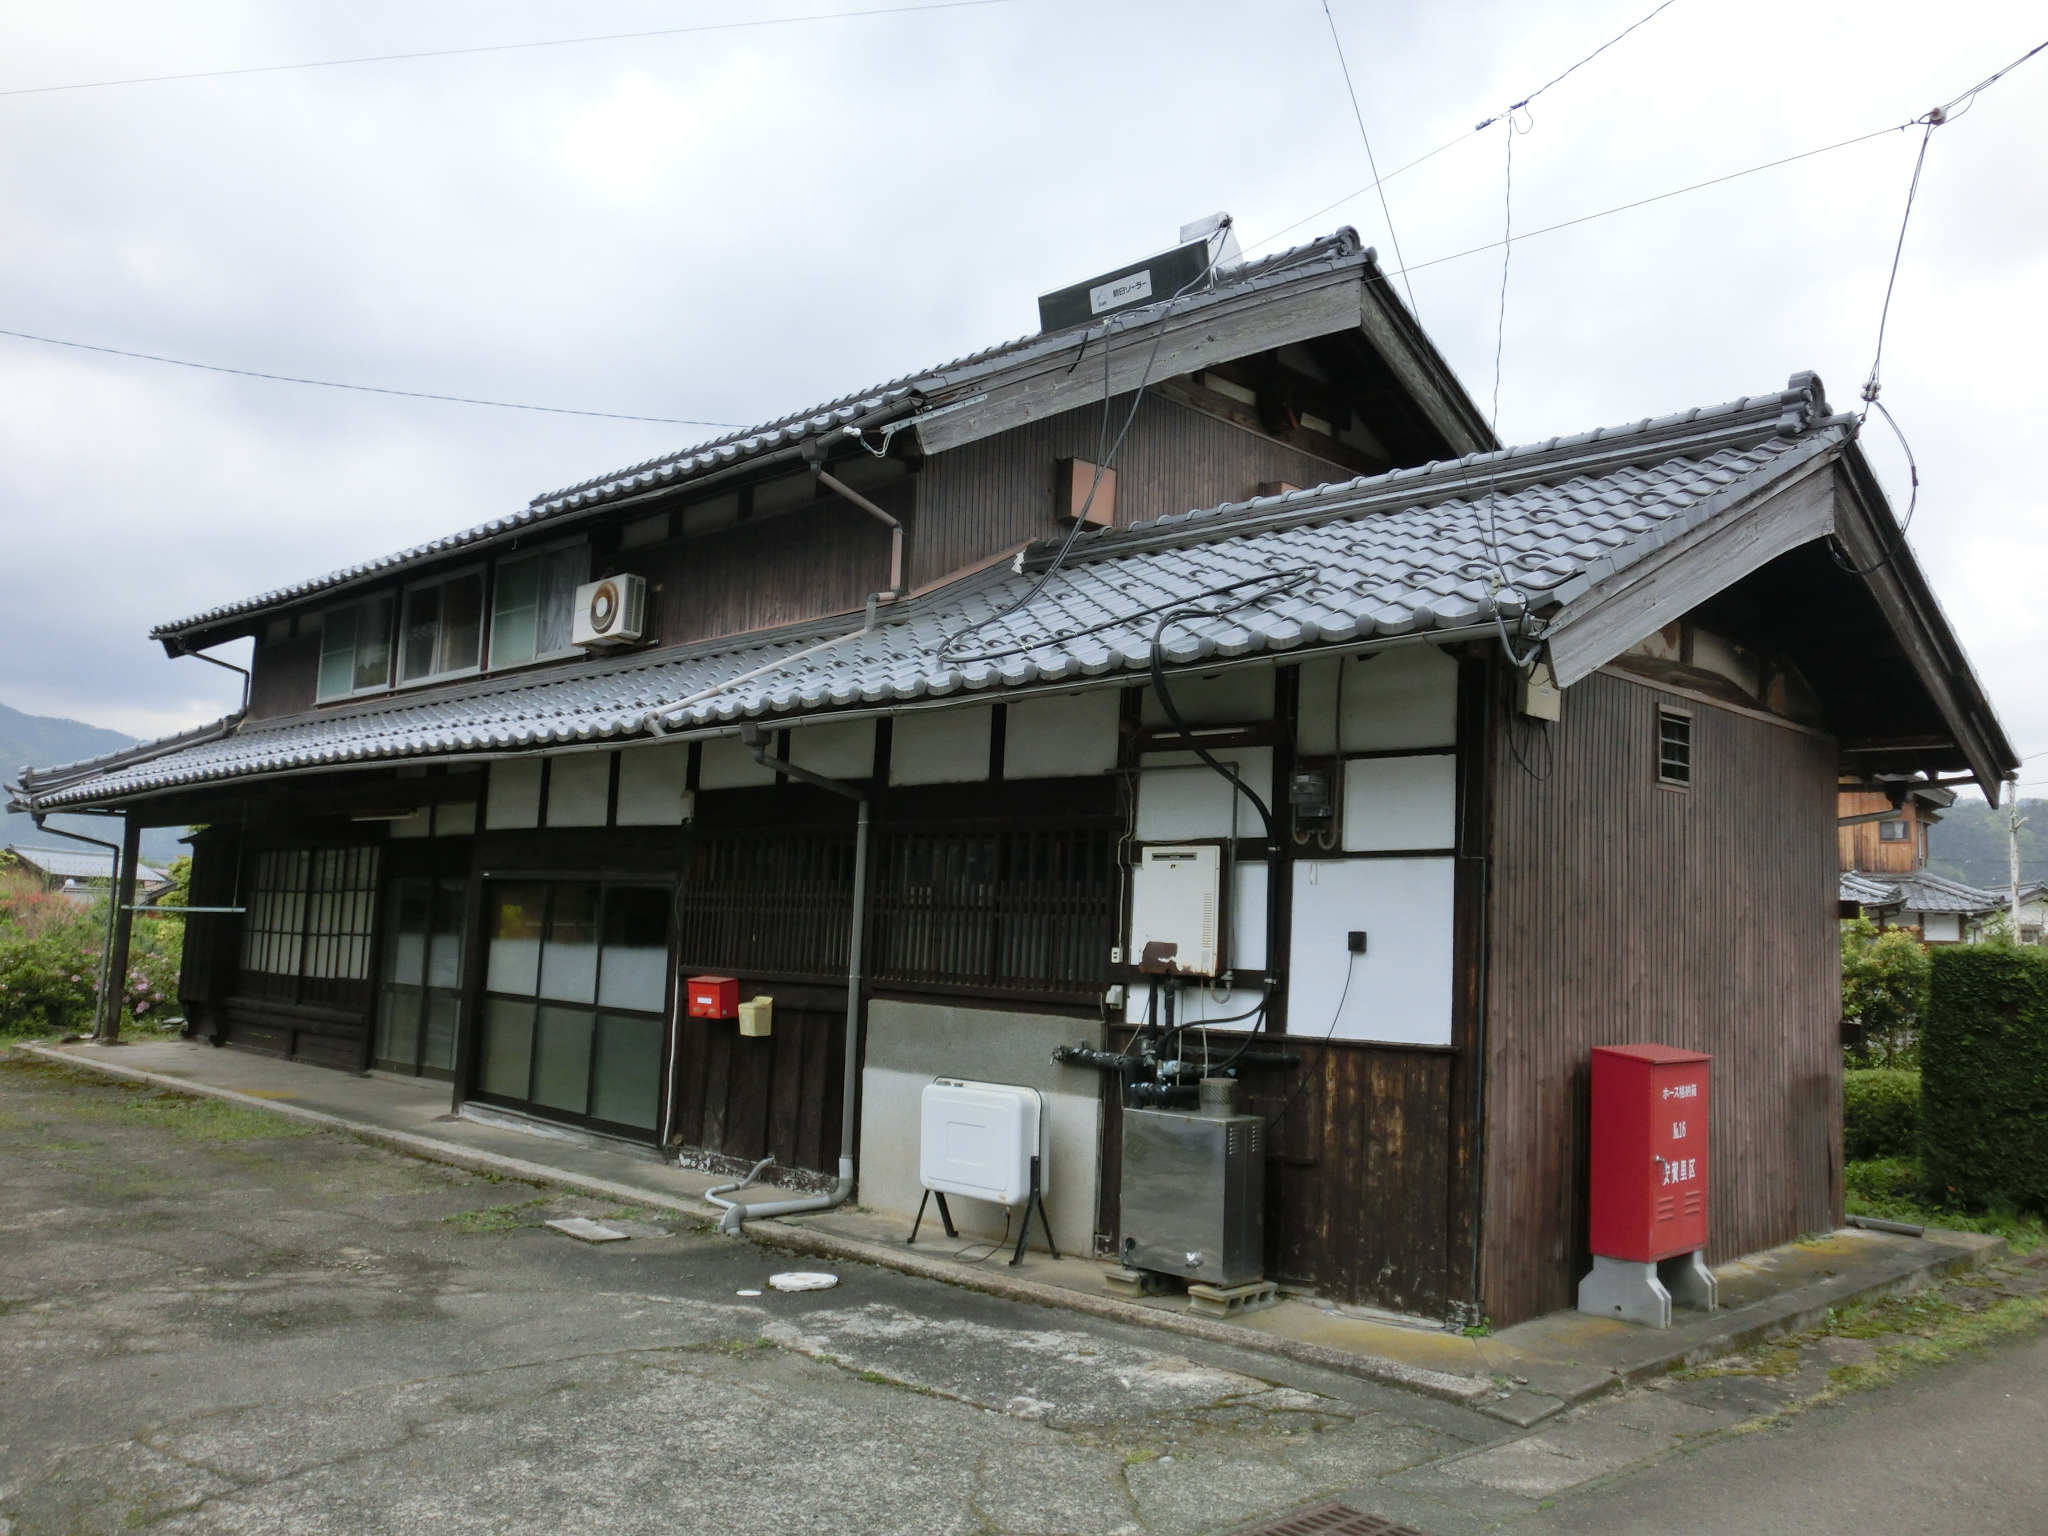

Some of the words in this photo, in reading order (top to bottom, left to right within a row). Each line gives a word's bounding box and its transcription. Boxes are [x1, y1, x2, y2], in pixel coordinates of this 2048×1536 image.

[1662, 1084, 1697, 1099] ホース格納箱
